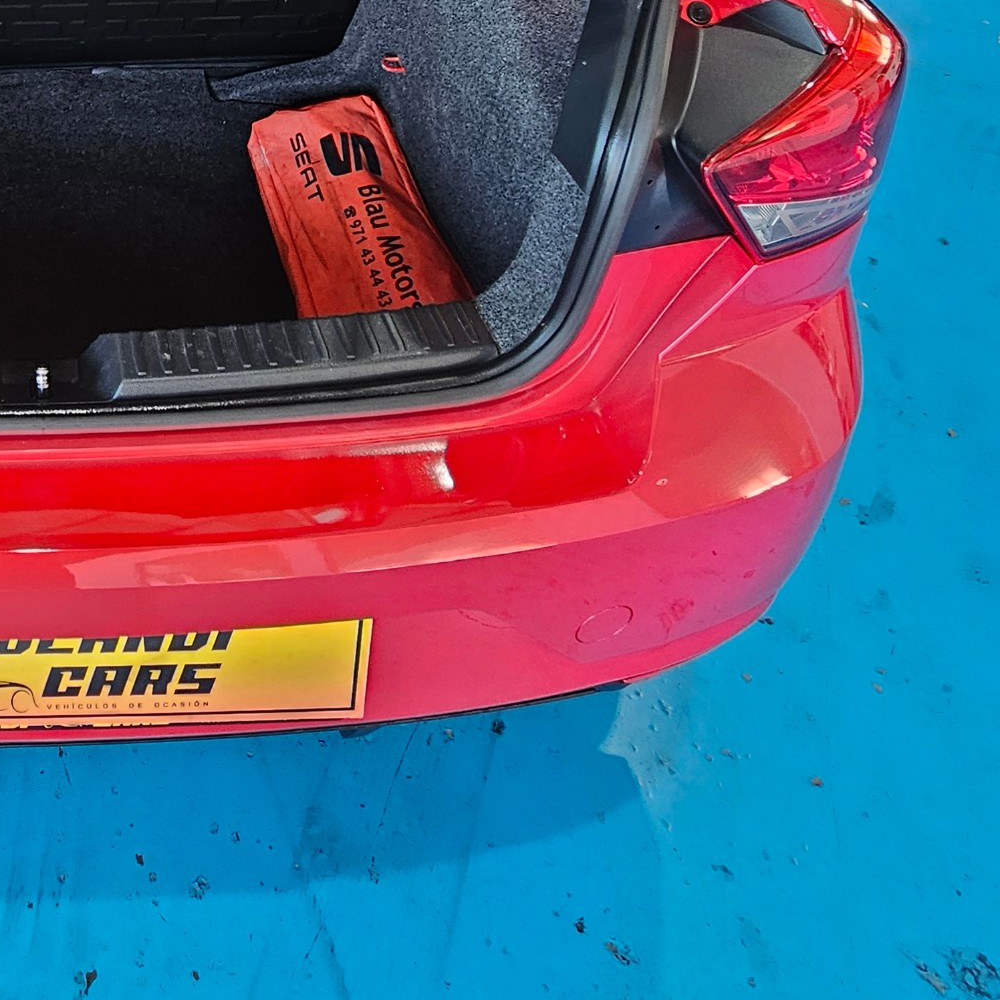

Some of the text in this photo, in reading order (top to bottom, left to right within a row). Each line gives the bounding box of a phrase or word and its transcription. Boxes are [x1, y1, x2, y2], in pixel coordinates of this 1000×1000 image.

[290, 132, 324, 201] SEAT
[358, 184, 389, 229] Blau
[350, 219, 392, 308] 971 43 44 43
[42, 663, 222, 697] CARS
[46, 702, 117, 710] VEHÍCULOS
[154, 700, 209, 709] OCASIÓN
